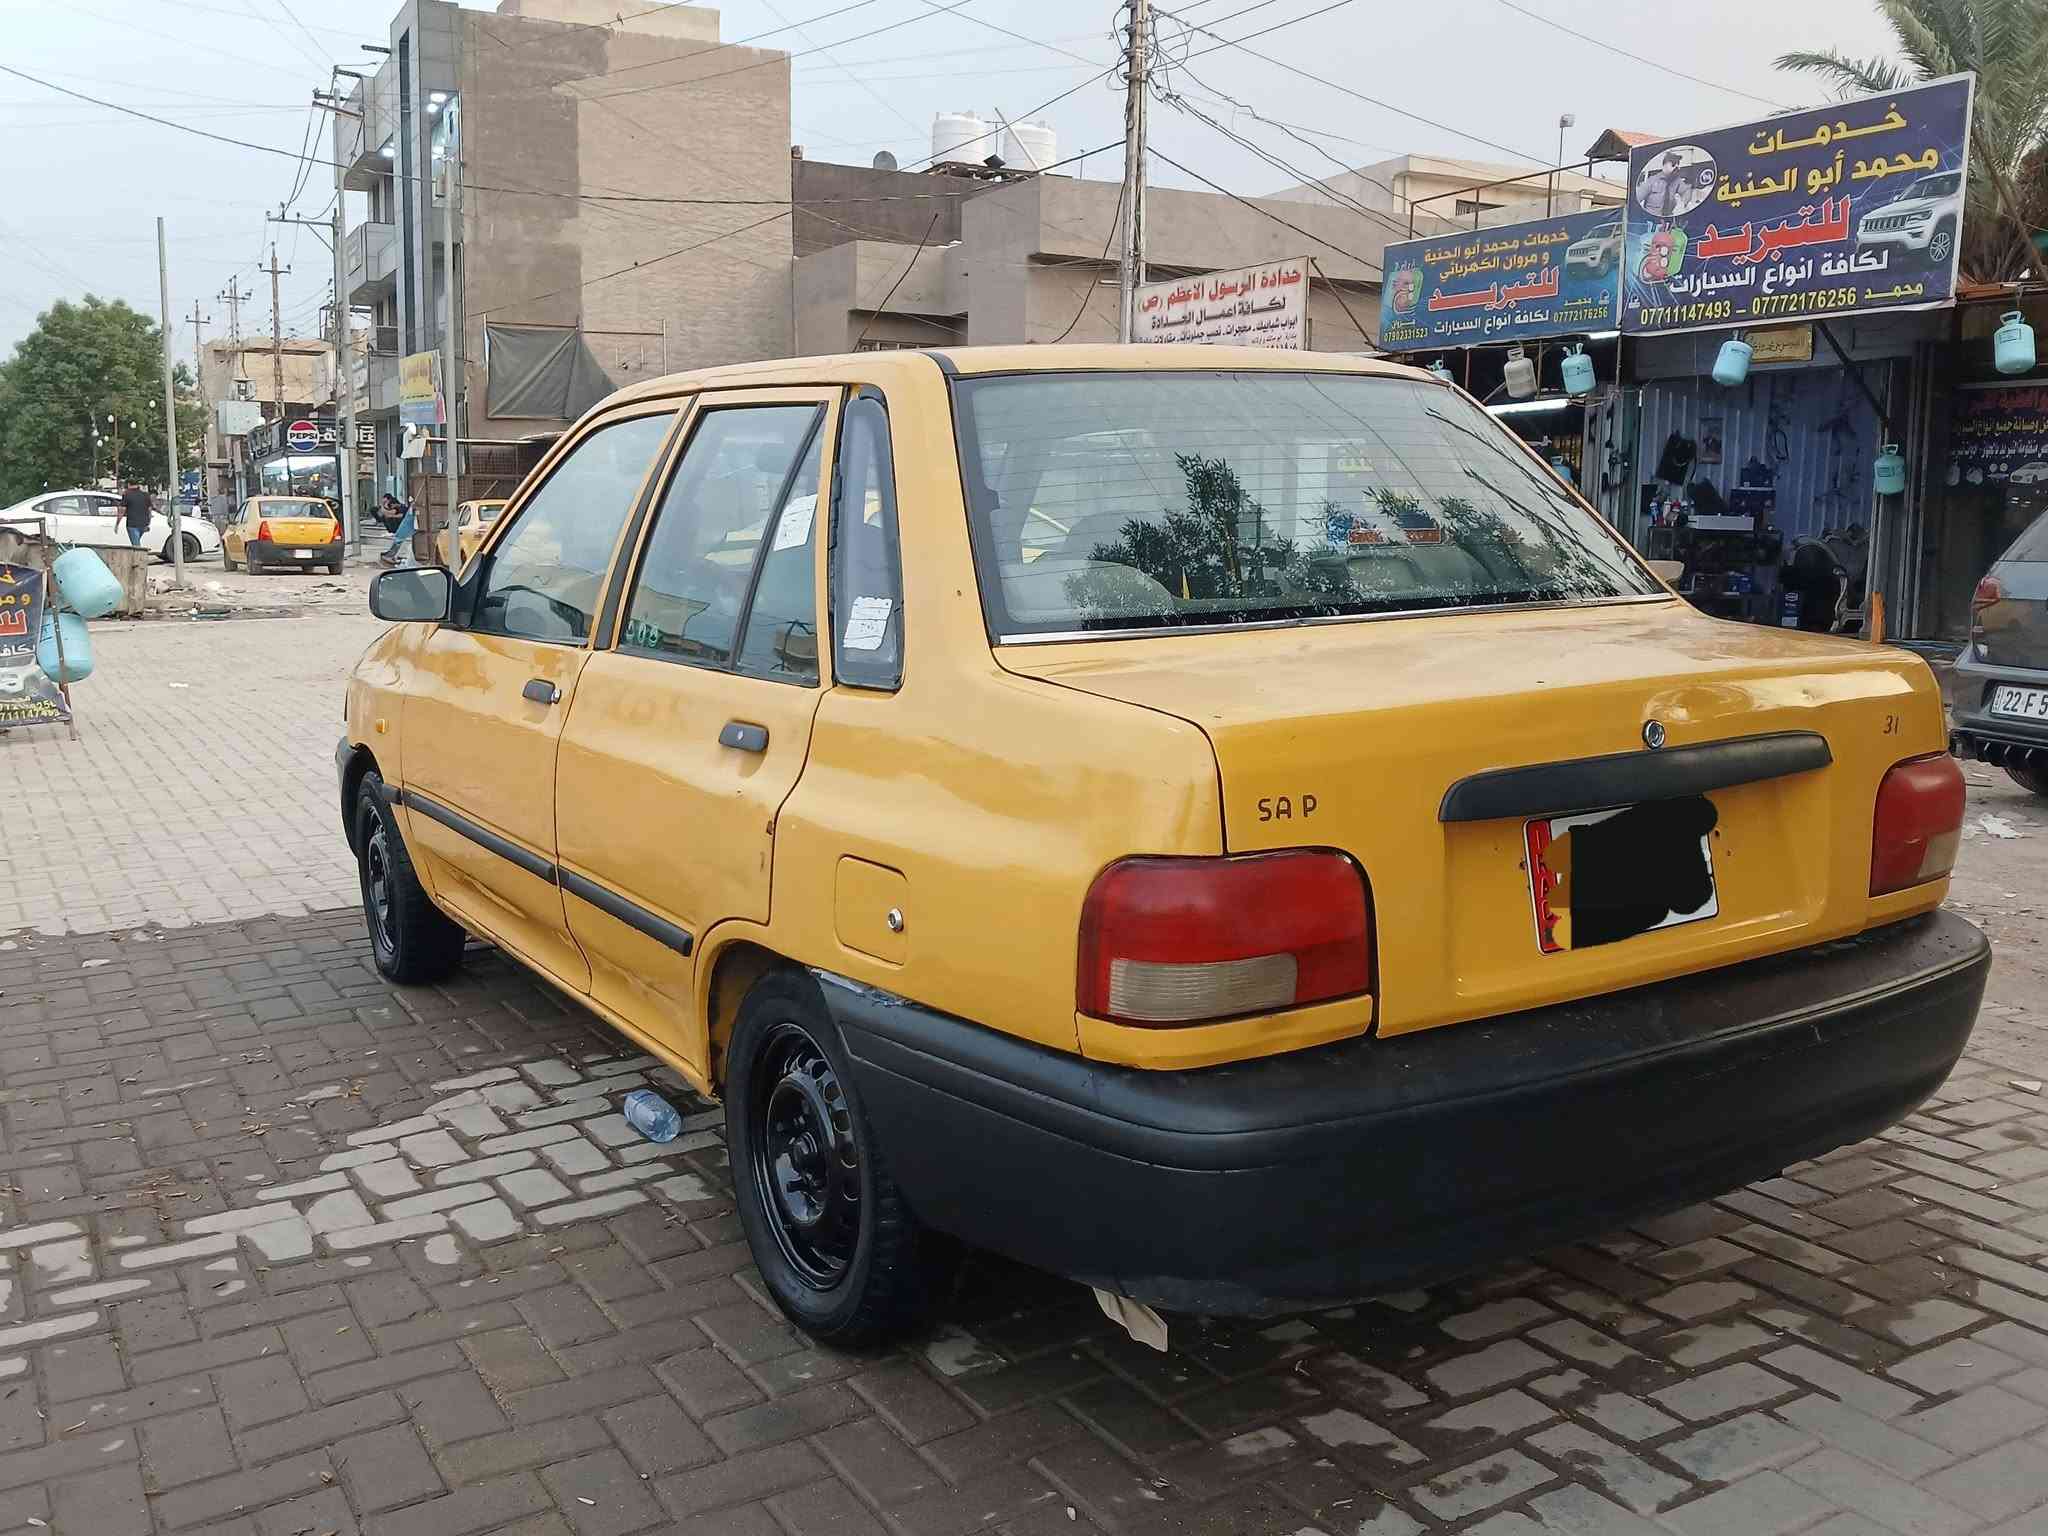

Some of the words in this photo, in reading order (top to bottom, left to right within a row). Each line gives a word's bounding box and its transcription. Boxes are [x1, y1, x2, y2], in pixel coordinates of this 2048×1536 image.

[1749, 102, 1907, 156] خدمات
[1807, 149, 1845, 195] أبو
[1852, 148, 1939, 180] محمد
[1717, 167, 1798, 208] الحنية
[1523, 227, 1569, 247] خدمات
[1696, 194, 1851, 266] للتبريد
[1464, 238, 1481, 259] أبو
[1484, 237, 1519, 255] محمد
[1541, 251, 1549, 265] و
[1503, 254, 1538, 272] مروان
[1821, 249, 1889, 276] لكافة
[1208, 272, 1256, 302] الرسول
[1260, 267, 1302, 289] حدادة
[1669, 265, 1757, 298] السيارات
[1763, 258, 1814, 294] انواع
[1427, 265, 1560, 312] للتبريد
[1864, 281, 1924, 300] محمد
[1640, 300, 1731, 326] 07711147493
[1752, 287, 1858, 316] 07772176256
[1433, 318, 1481, 336] السيارات
[1484, 312, 1511, 334] انواع
[1514, 308, 1550, 325] لكافة
[289, 432, 318, 440] PEPSI
[2002, 690, 2022, 713] 22
[2024, 692, 2037, 713] F
